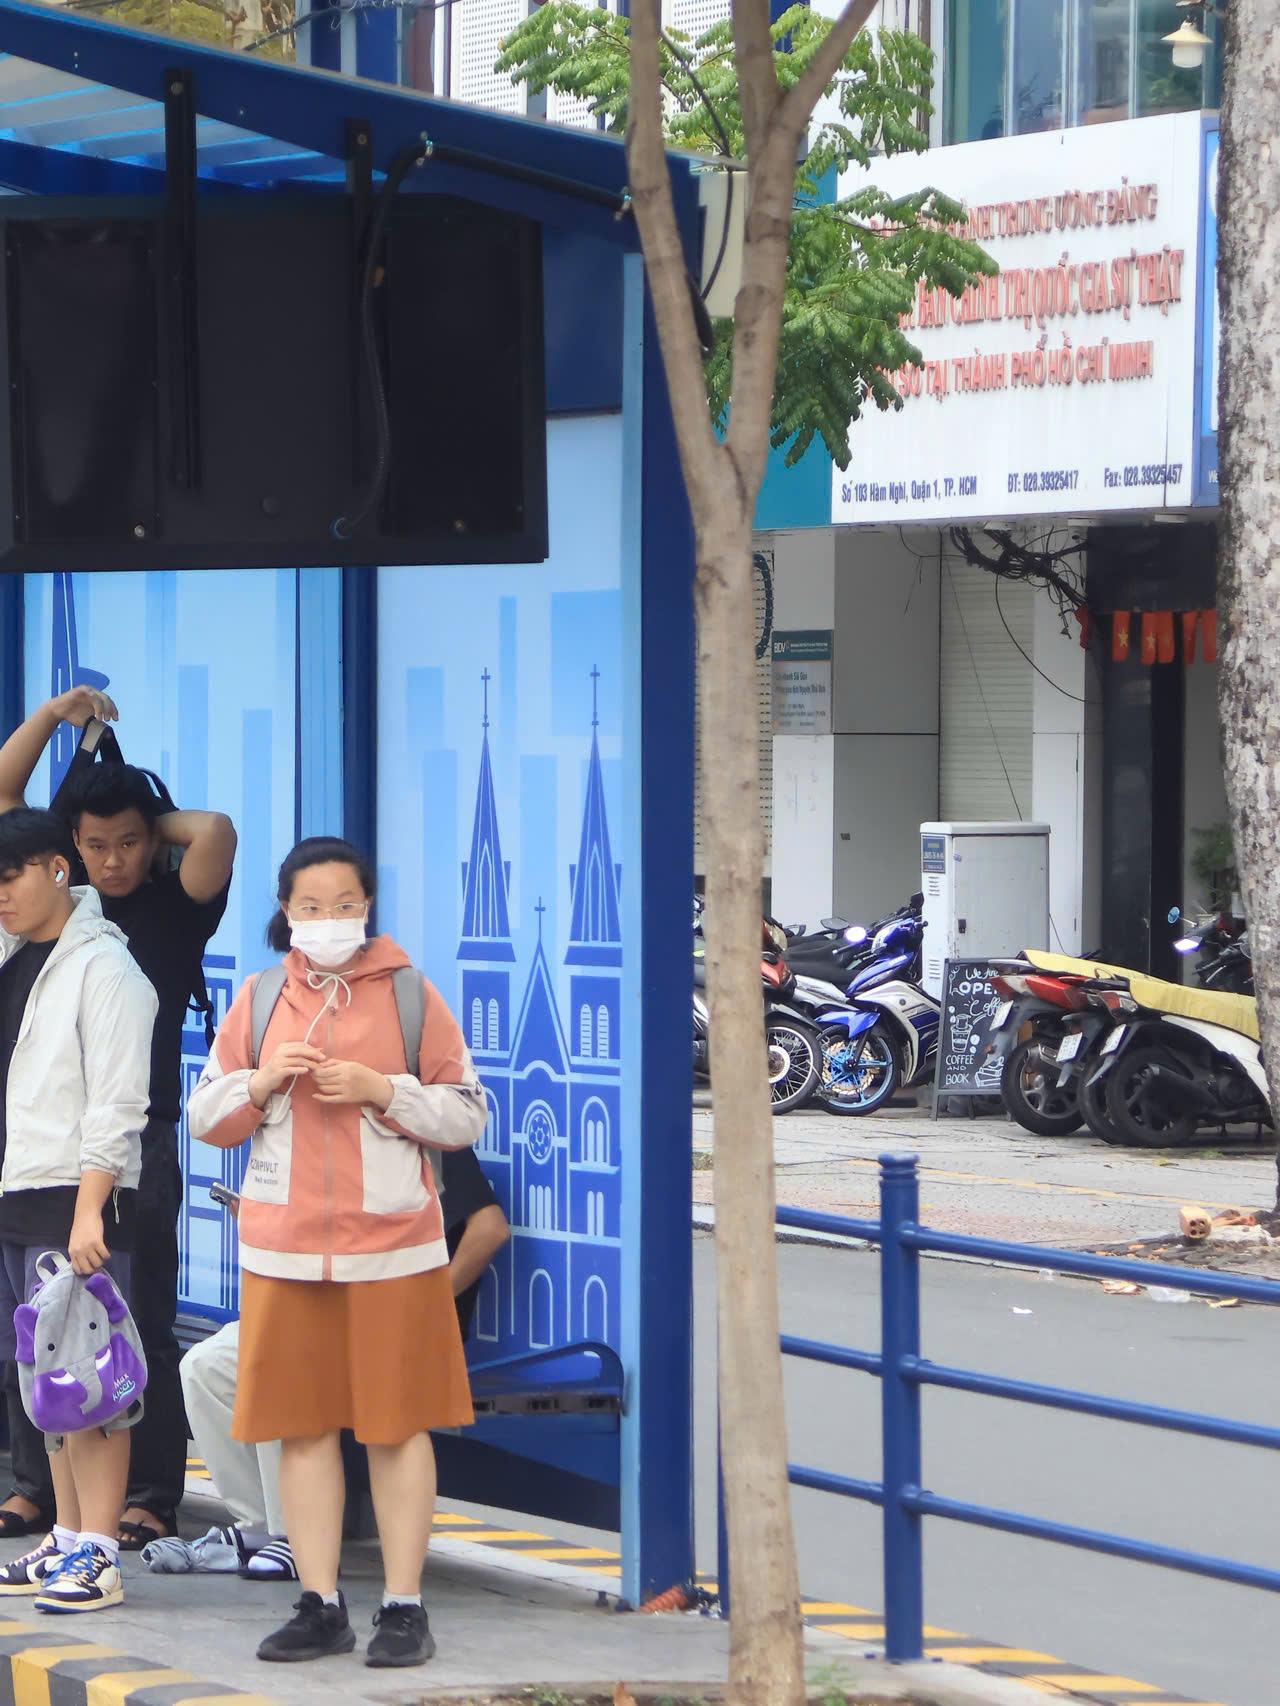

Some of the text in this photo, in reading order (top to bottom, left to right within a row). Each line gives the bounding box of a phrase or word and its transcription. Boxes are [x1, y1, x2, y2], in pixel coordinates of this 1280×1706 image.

[1108, 340, 1154, 384] MINH
[855, 483, 868, 502] 103
[870, 482, 887, 502] Hàm
[959, 475, 978, 496] HCM
[1104, 467, 1122, 488] Fax:
[958, 981, 998, 995] OPE
[945, 1054, 975, 1066] COFFEE
[945, 1073, 970, 1085] BOOK
